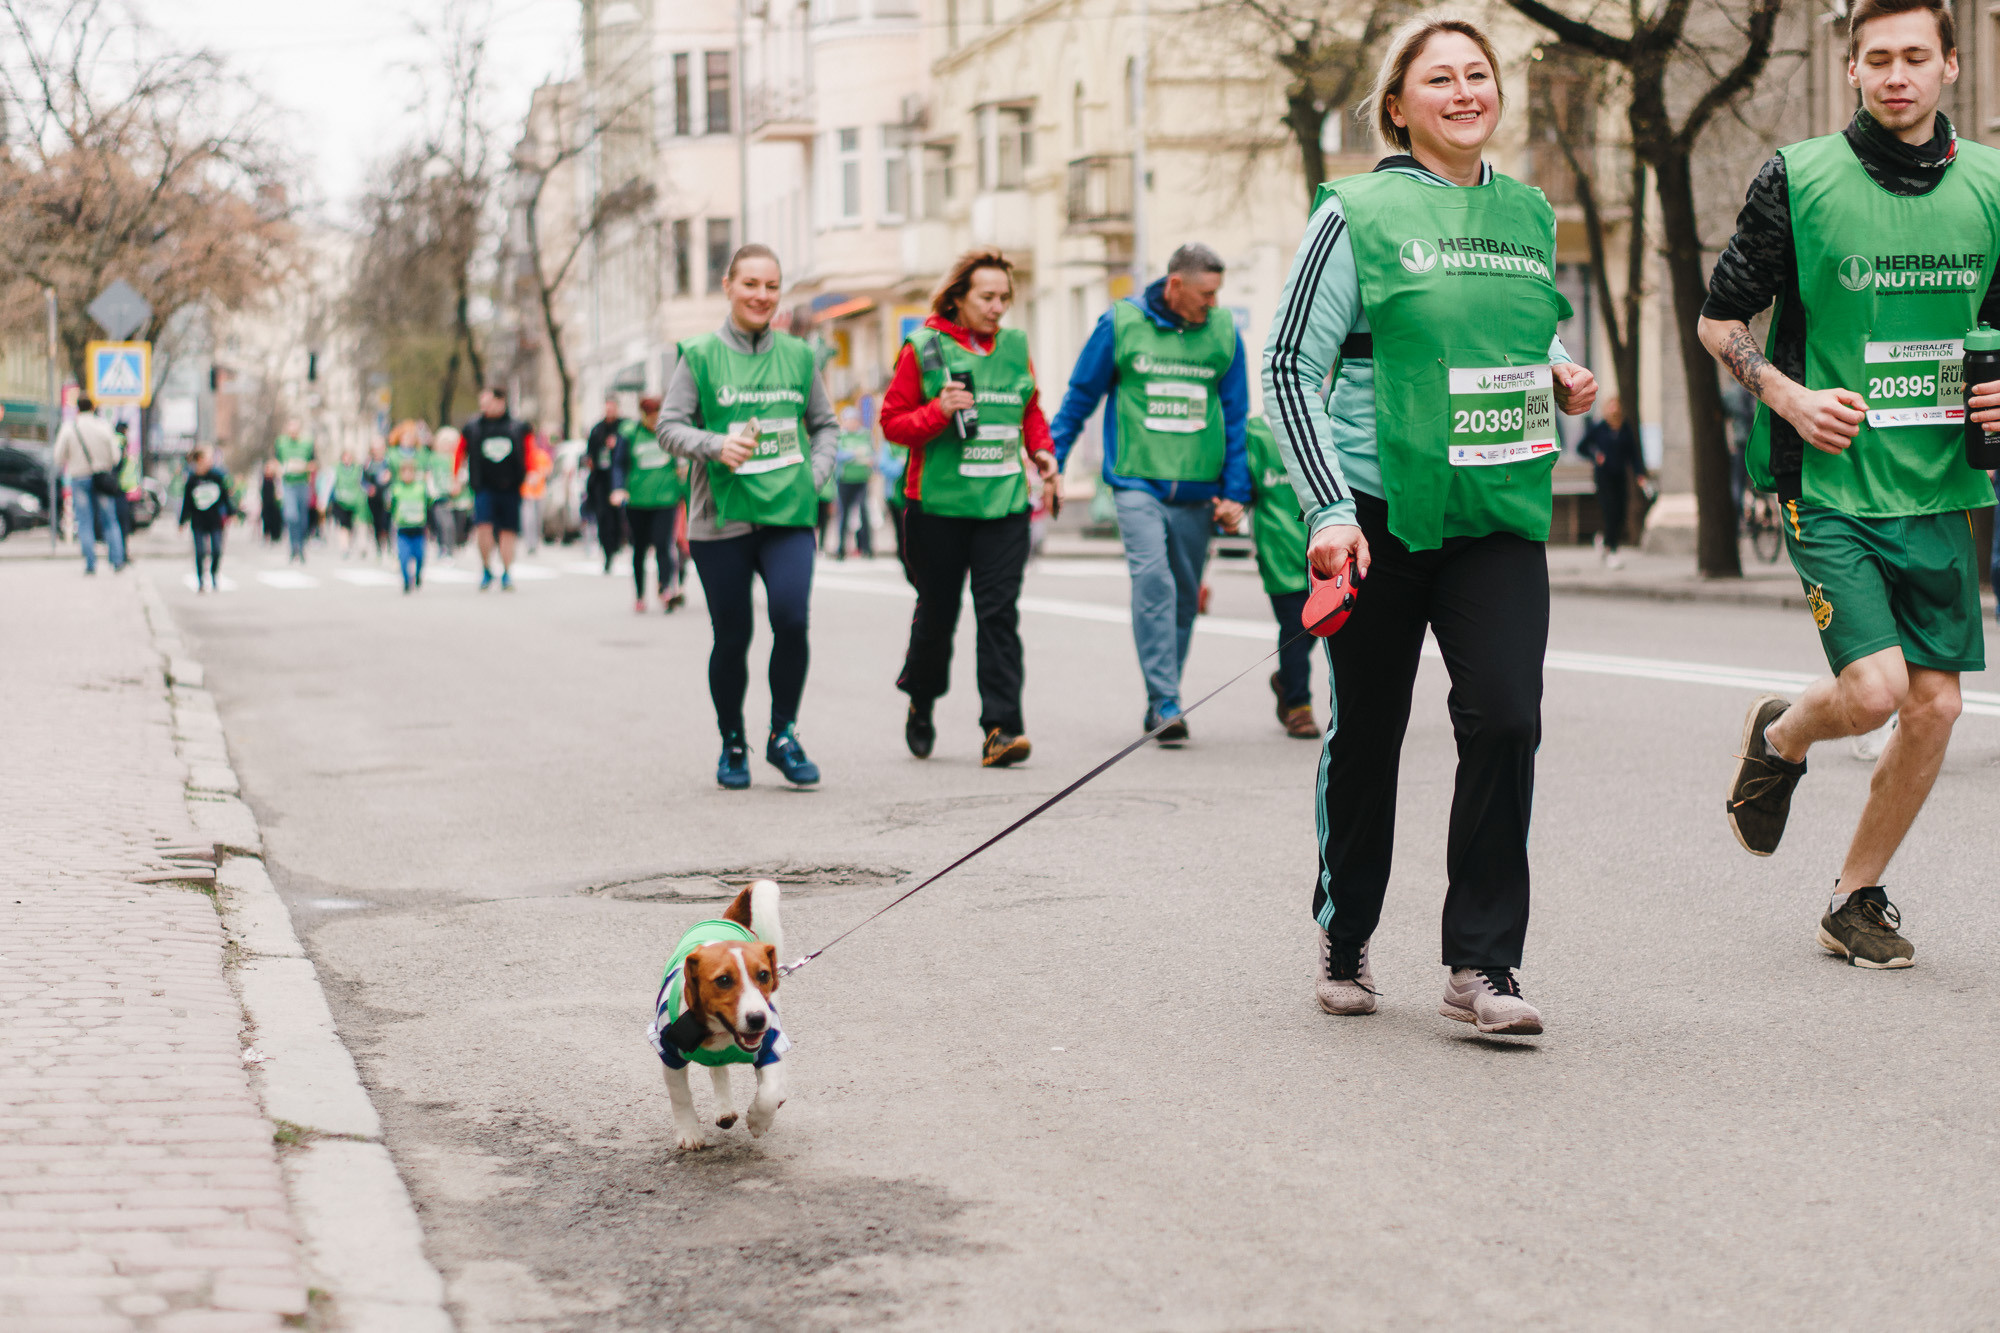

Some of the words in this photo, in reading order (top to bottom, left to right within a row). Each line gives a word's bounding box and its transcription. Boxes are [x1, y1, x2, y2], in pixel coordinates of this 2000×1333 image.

[1438, 237, 1546, 264] HERBALIFE
[1440, 252, 1551, 280] NUTRITION
[1875, 254, 1985, 270] HERBALIFE
[1903, 343, 1953, 351] HERBALIFE
[1902, 350, 1953, 358] NUTRITION
[1493, 371, 1535, 381] HERBALIFE
[1493, 379, 1536, 389] NUTRITION
[1869, 375, 1935, 399] 20395
[1941, 387, 1951, 396] 1,6
[1954, 387, 1963, 395] K
[1527, 394, 1548, 403] FAMILY
[1149, 401, 1188, 415] 20184
[1527, 401, 1549, 415] RUN
[1453, 407, 1523, 433] 20393
[1526, 420, 1536, 430] 1,6
[1537, 418, 1549, 427] KM
[964, 447, 1003, 460] 20205
